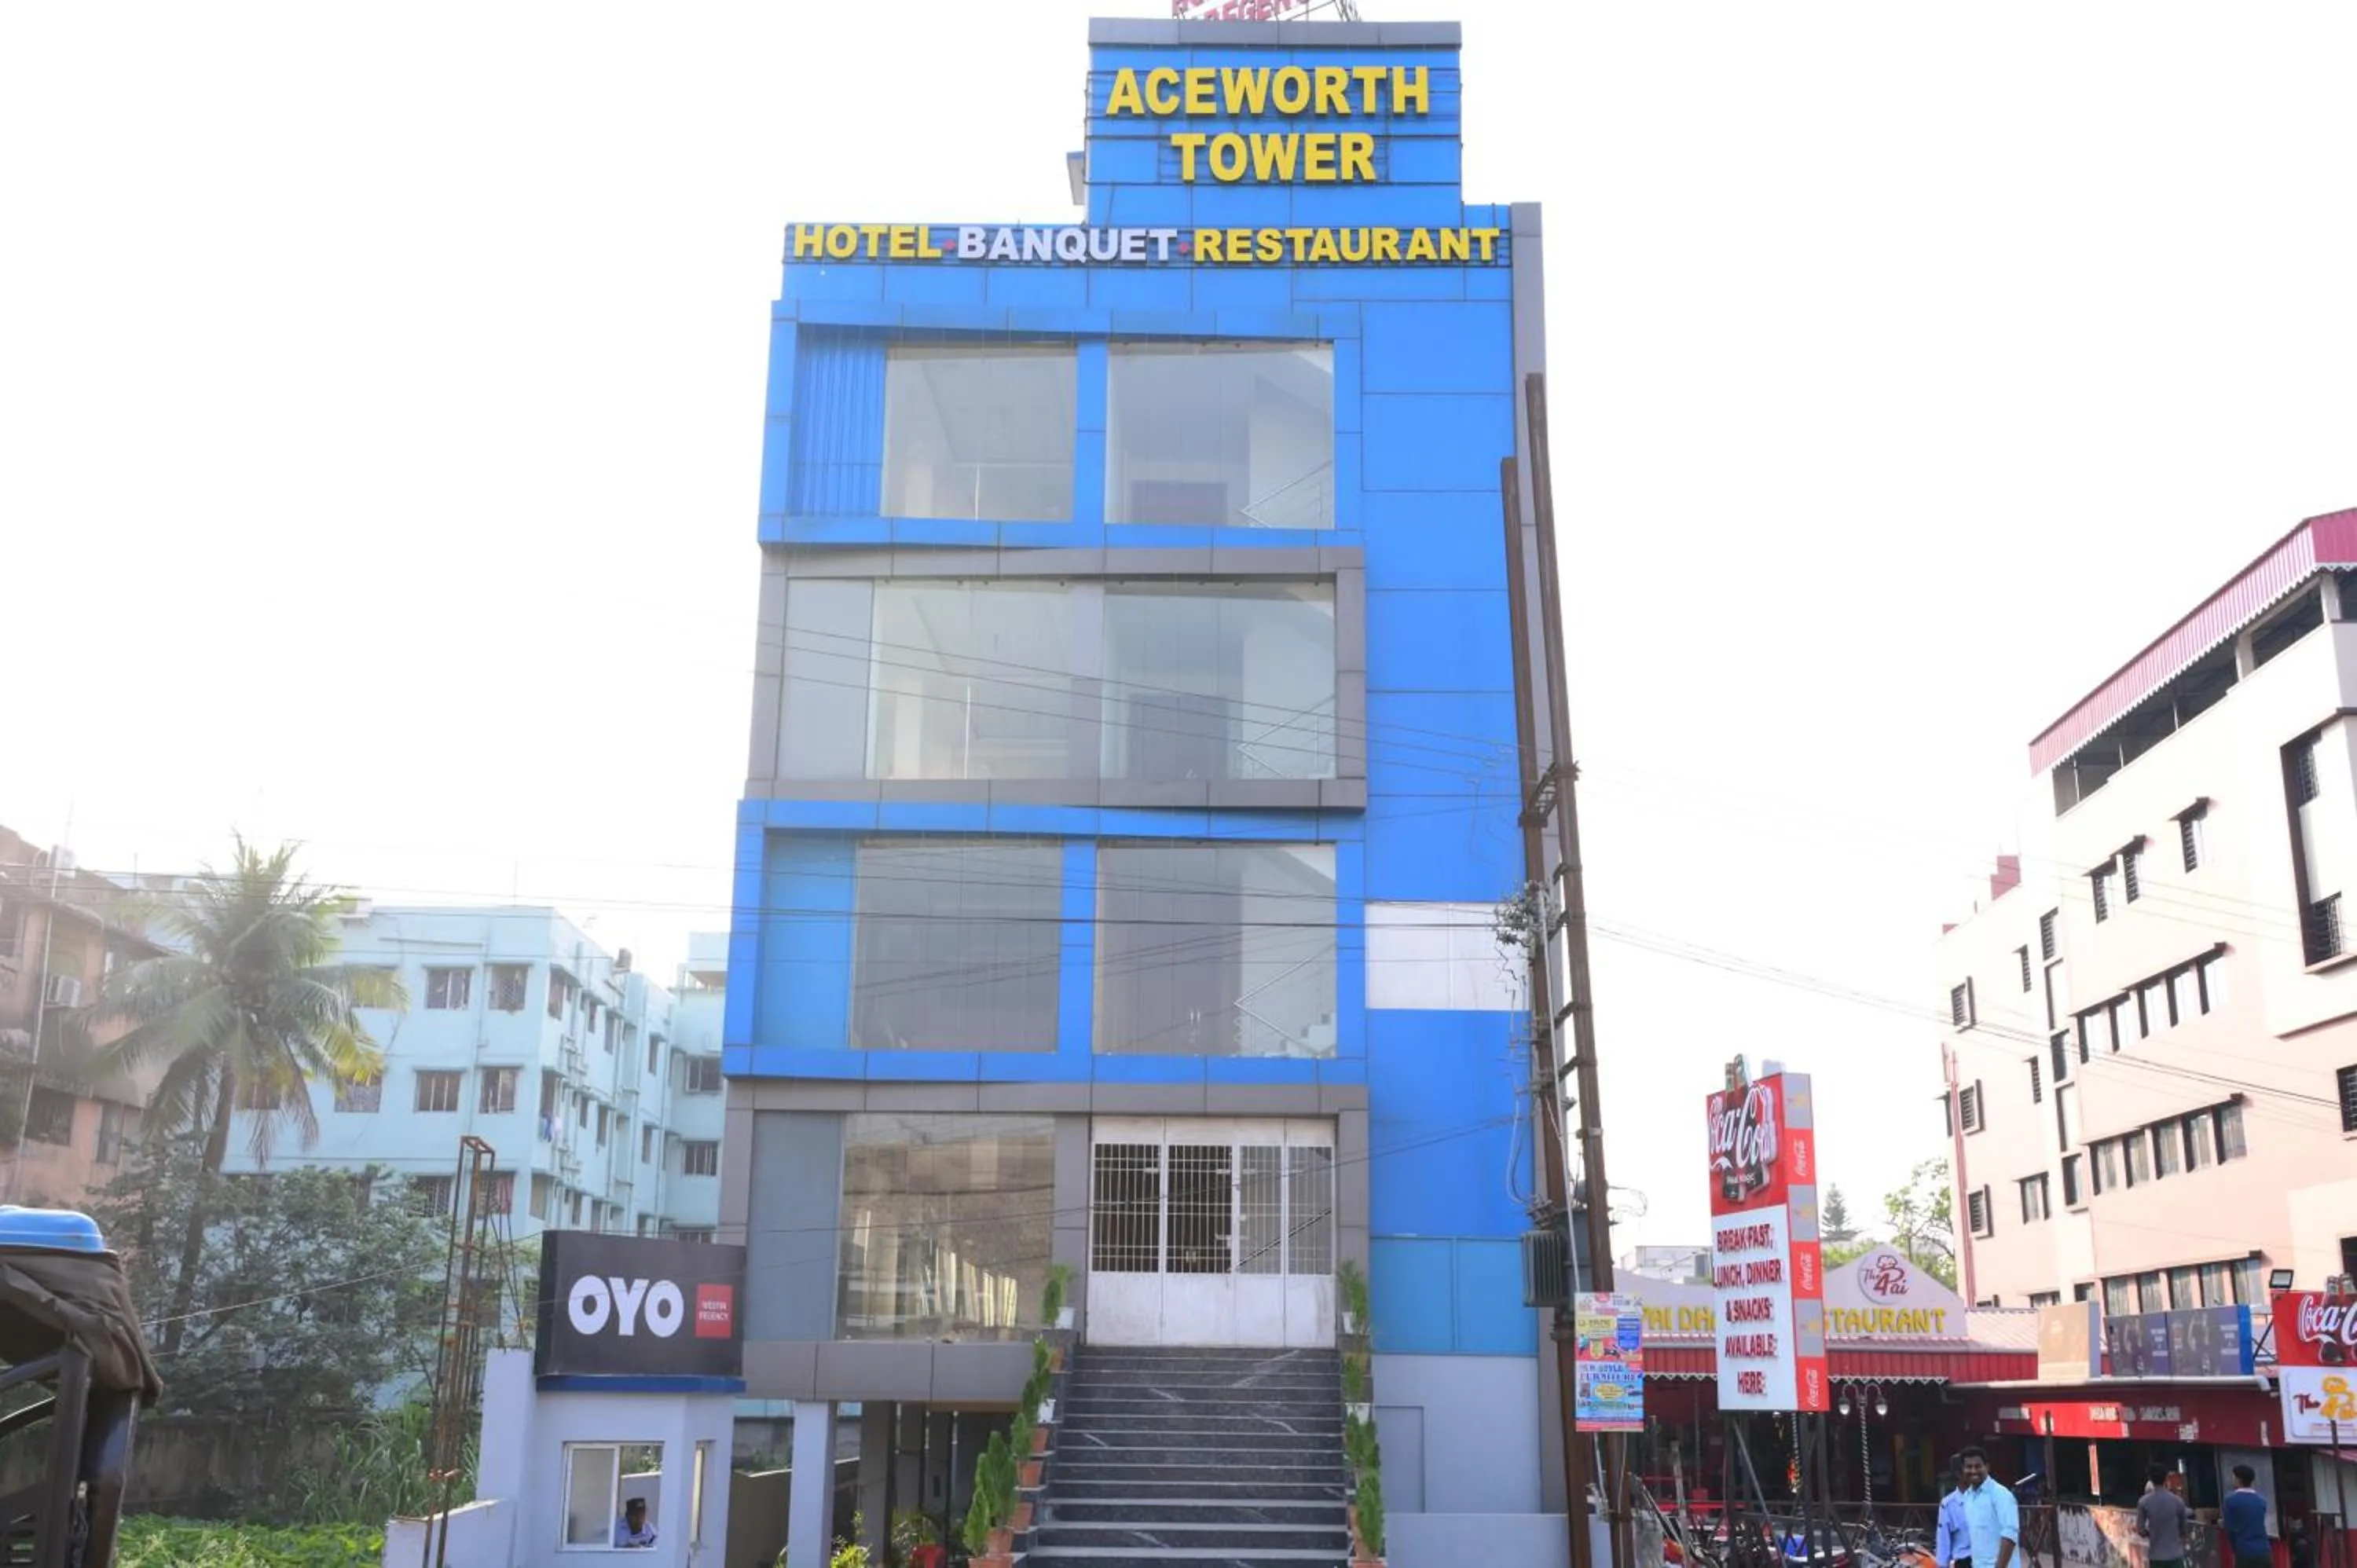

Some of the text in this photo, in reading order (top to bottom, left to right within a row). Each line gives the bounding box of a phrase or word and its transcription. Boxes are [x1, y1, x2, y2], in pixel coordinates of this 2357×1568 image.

[1105, 66, 1429, 115] ACEWORTH
[1171, 132, 1376, 182] TOWER
[793, 225, 1500, 263] HOTEL BANQUET RESTAURANT
[1747, 1258, 1782, 1284] DINNER
[568, 1274, 684, 1338] OYO
